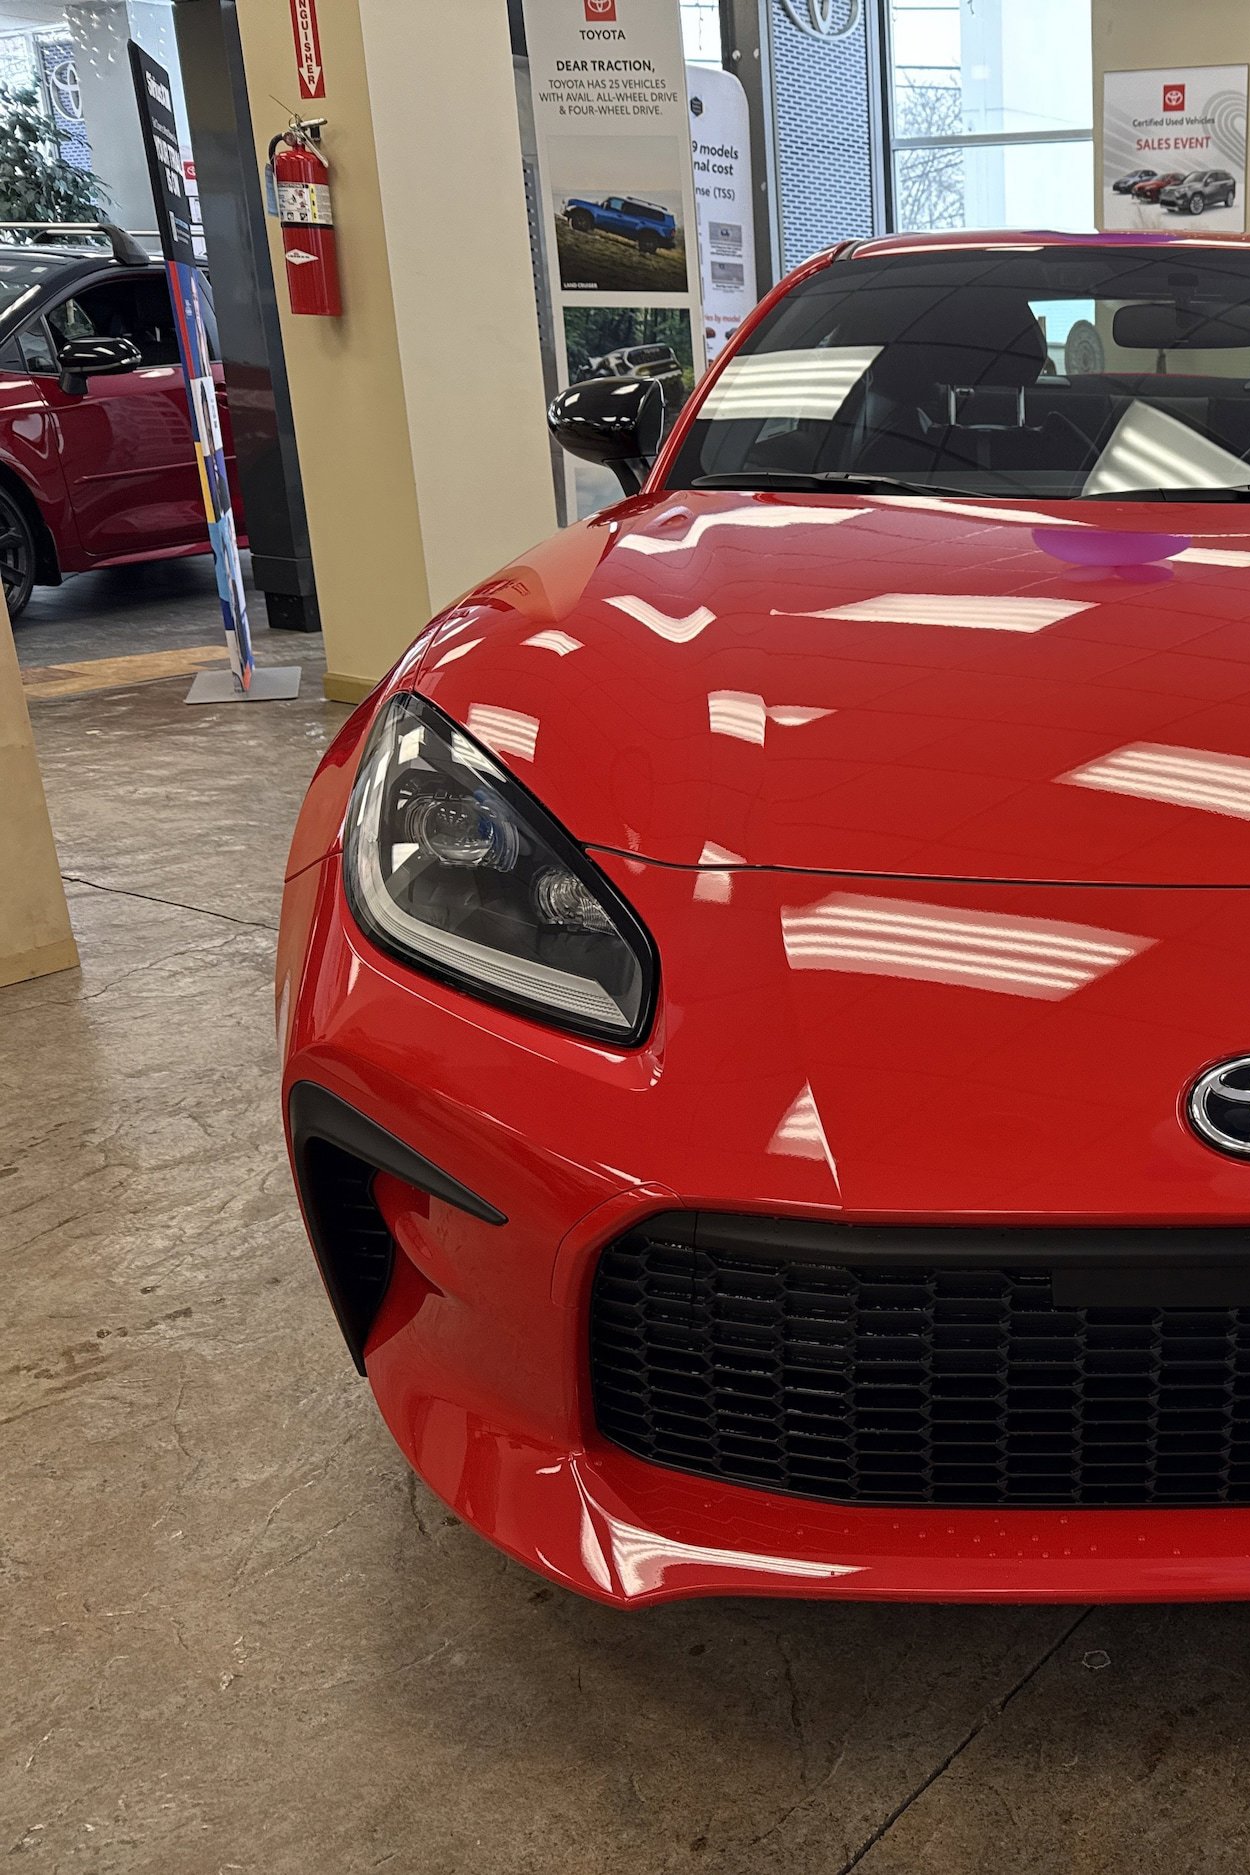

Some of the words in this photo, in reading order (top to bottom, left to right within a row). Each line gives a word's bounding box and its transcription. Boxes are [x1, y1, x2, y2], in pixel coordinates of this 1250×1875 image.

[579, 30, 626, 40] TOYOTA
[556, 60, 588, 72] DEAR
[591, 60, 656, 73] TRACTION,
[549, 79, 586, 89] TOYOTA
[587, 79, 607, 89] HAS
[609, 79, 620, 89] 25
[621, 79, 666, 89] VEHICLES
[539, 92, 564, 102] WITH
[566, 92, 595, 102] AVAIL.
[596, 92, 649, 103] ALL-WHEEL
[650, 92, 679, 102] DRIVE
[559, 105, 567, 115] &
[568, 105, 631, 115] FOUR-WHEEL
[632, 105, 663, 115] DRIVE.
[1132, 118, 1164, 127] Certified
[1165, 117, 1184, 126] Used
[1185, 116, 1215, 125] Vehicles
[1136, 138, 1171, 151] SALES
[1173, 135, 1212, 149] EVENT
[699, 143, 739, 160] models
[712, 162, 734, 176] cost
[713, 186, 735, 202] (TSS)
